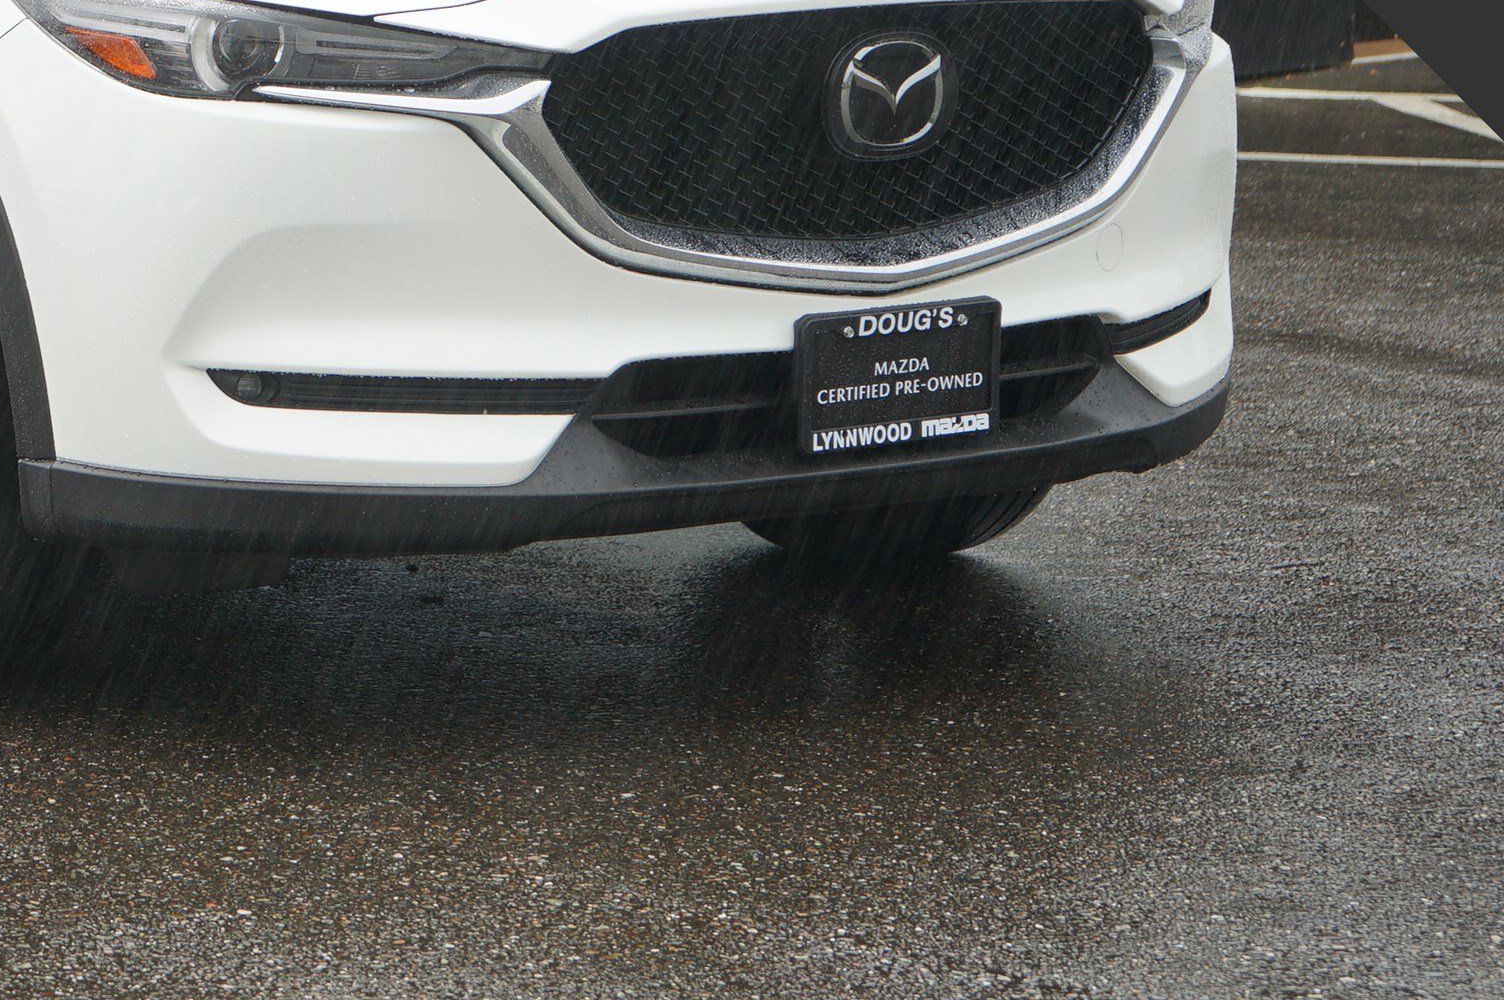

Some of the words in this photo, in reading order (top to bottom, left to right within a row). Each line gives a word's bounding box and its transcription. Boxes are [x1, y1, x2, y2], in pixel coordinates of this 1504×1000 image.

[858, 307, 954, 337] DOUG'S
[874, 357, 930, 377] MAZDA
[817, 383, 891, 405] CERTIFIED
[895, 372, 983, 396] PRE-OWNED
[812, 422, 912, 452] LYNNWOOD
